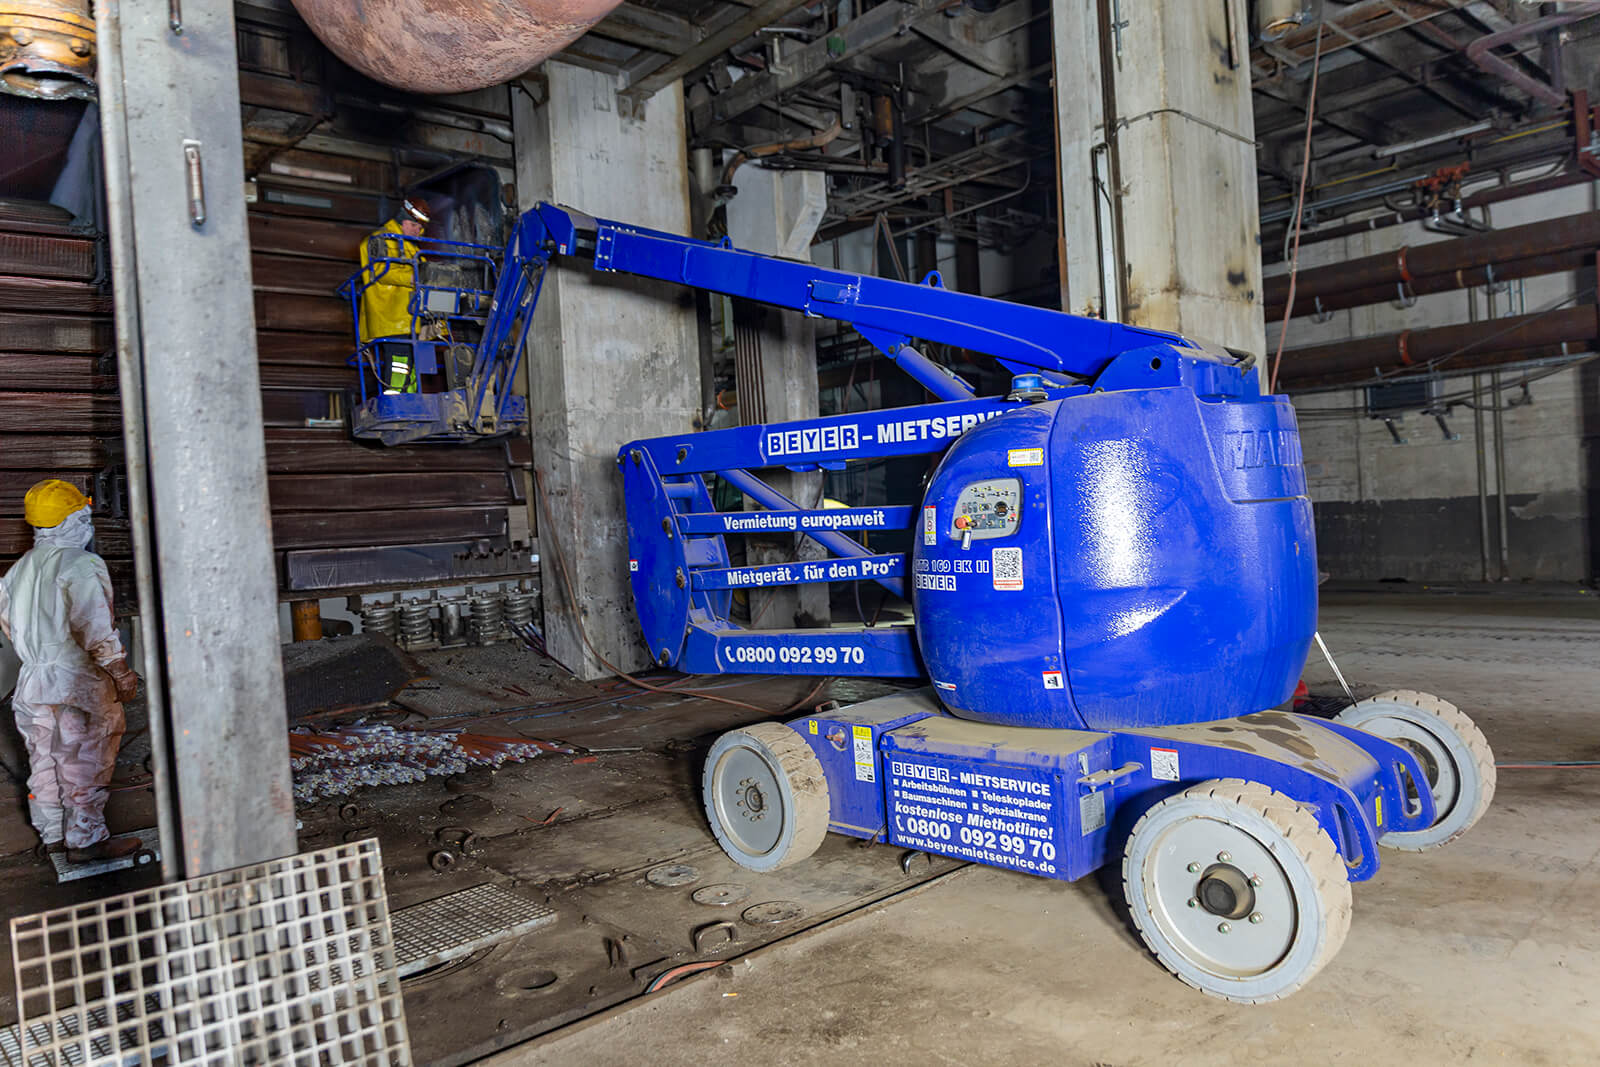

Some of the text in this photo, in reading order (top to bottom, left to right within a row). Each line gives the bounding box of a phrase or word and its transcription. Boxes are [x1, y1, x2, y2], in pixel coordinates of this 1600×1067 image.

[768, 424, 859, 456] BEYER
[723, 510, 885, 530] Vermietung europaweit
[727, 558, 900, 586] Mietgerät für den Pro
[915, 573, 957, 591] BEYER
[953, 559, 973, 573] EK
[736, 646, 865, 664] 0800 092 99 70
[892, 761, 950, 782] BEYER
[960, 772, 1051, 796] MIETSERVICE
[901, 779, 1052, 811] Arbeitsbühnen Teleskoplader
[902, 790, 1048, 823] Baumaschinen Spezialkrane
[895, 801, 963, 824] kostenlose
[967, 813, 1054, 840] Miethotline!
[897, 833, 1056, 874] www.beyer-mietservice.de
[907, 817, 1056, 861] 0800 092 99 70
